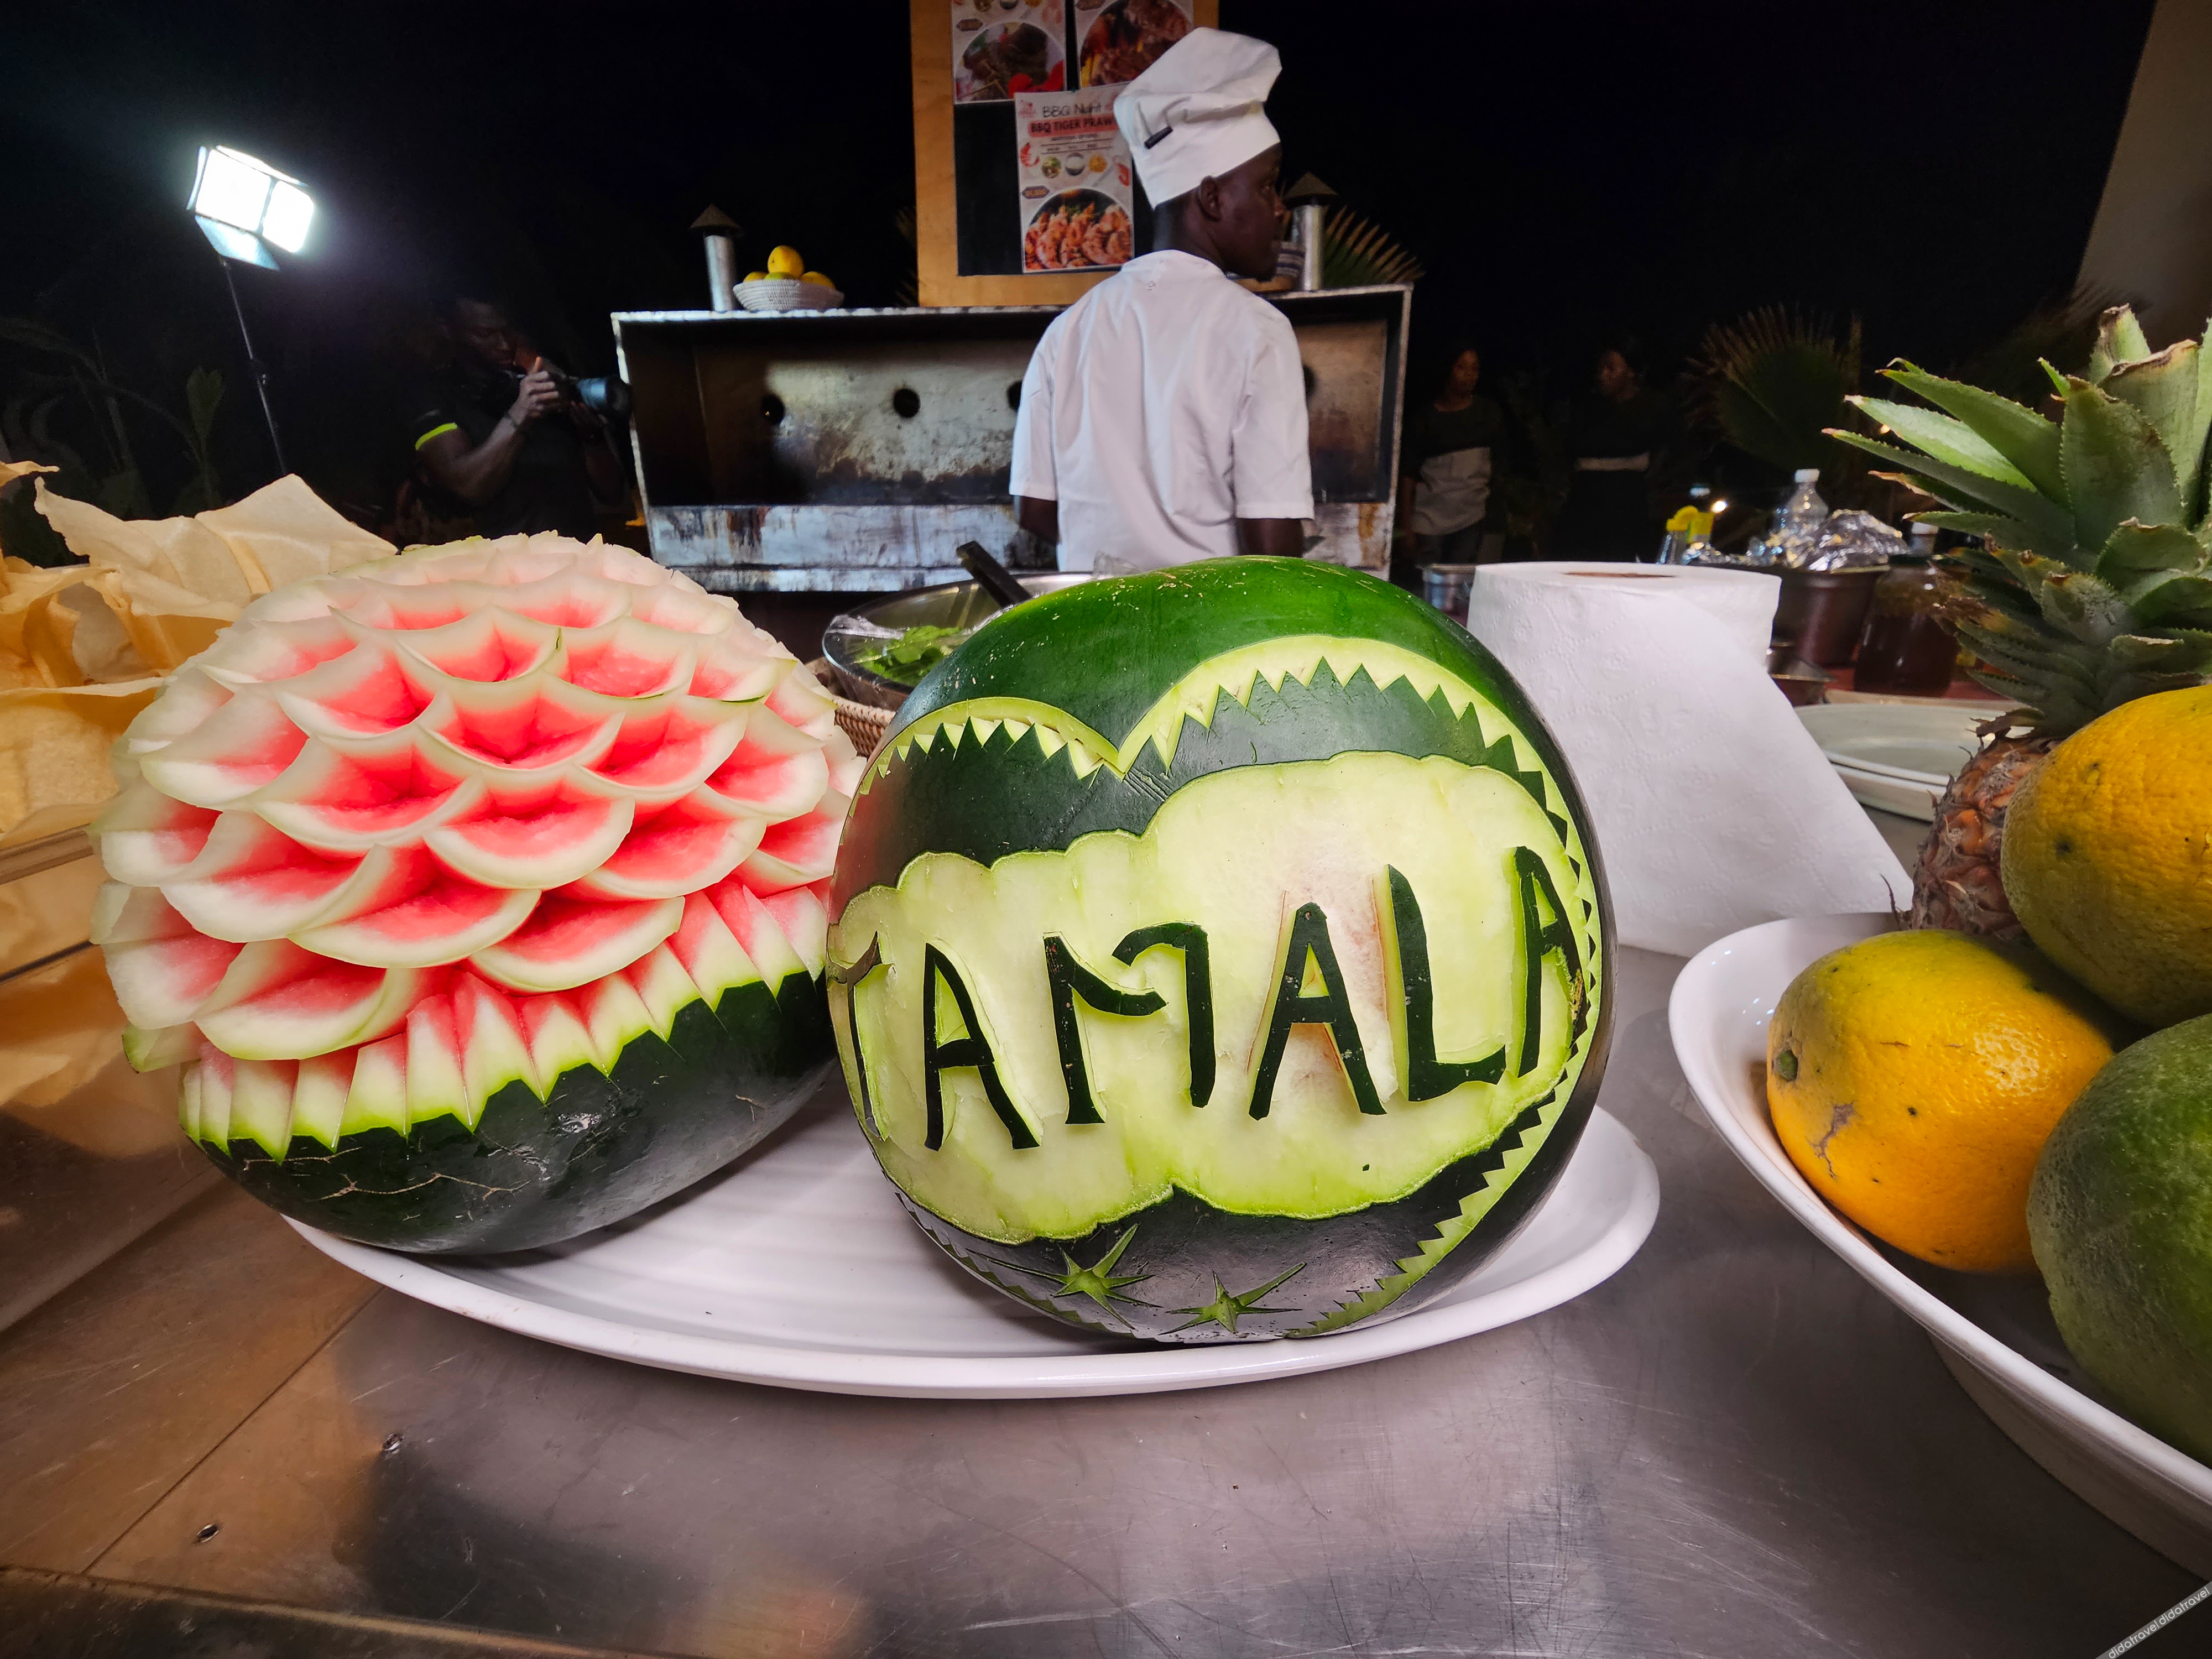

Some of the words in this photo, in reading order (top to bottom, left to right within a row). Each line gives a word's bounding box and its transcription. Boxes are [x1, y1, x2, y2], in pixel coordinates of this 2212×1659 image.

[1043, 105, 1071, 118] BBQ
[1031, 122, 1051, 133] BBQ
[1053, 118, 1080, 131] TIGER
[826, 846, 1590, 1152] TAMALA
